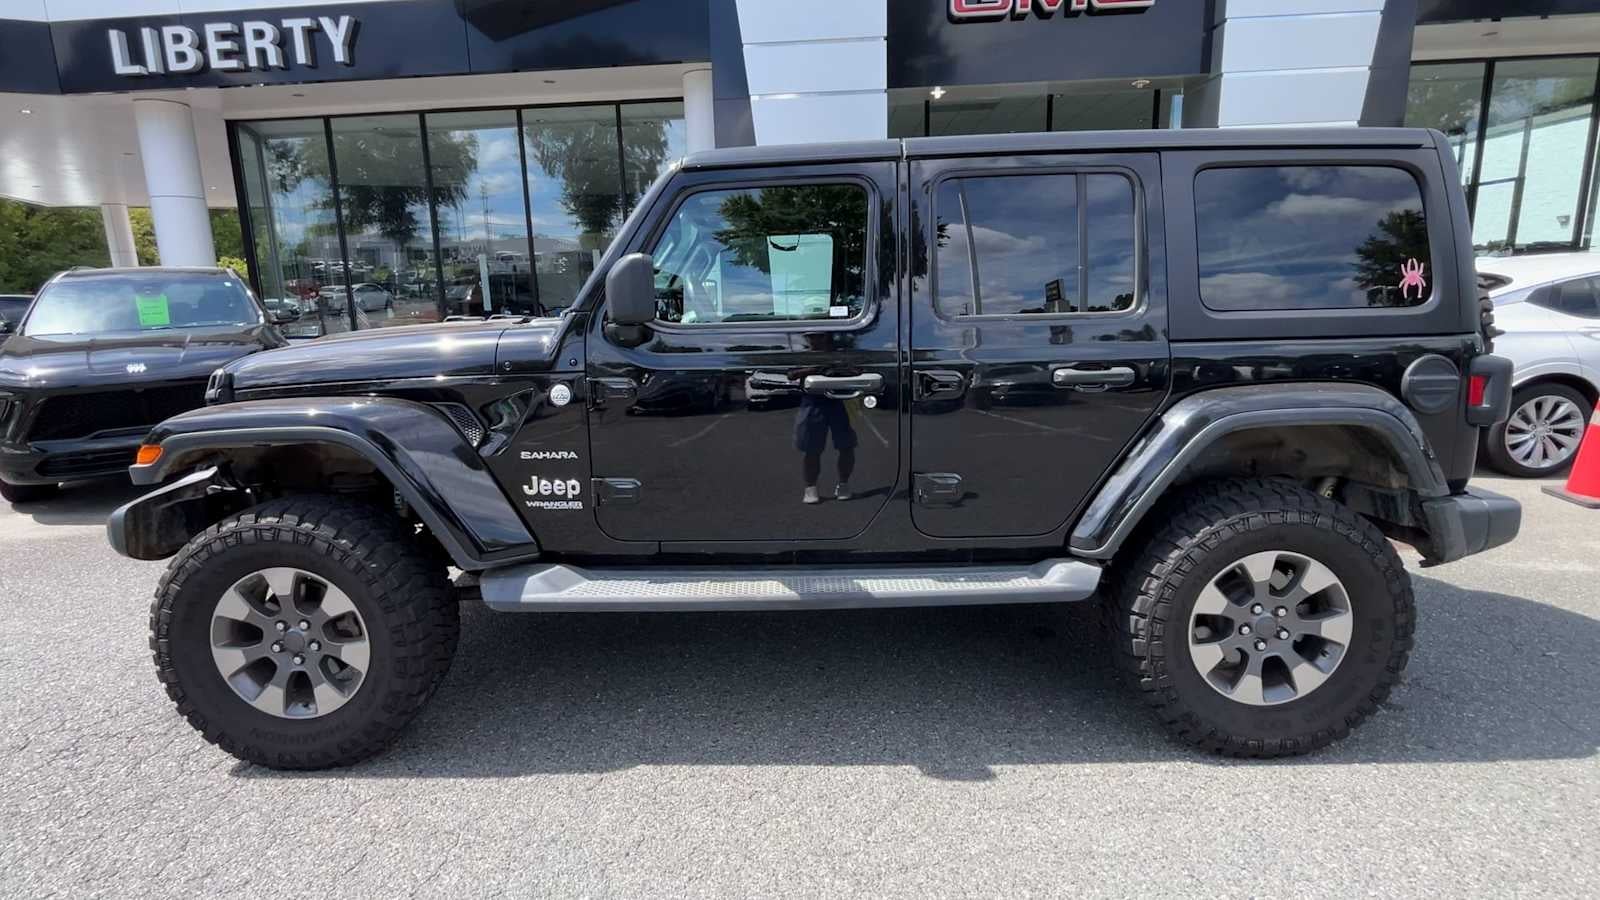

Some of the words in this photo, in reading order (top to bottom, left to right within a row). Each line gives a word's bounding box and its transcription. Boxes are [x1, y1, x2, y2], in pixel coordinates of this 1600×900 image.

[108, 15, 357, 76] LIBERTY
[520, 451, 578, 459] SAHARA
[522, 475, 581, 499] Jeep
[525, 500, 583, 508] WRANGLER
